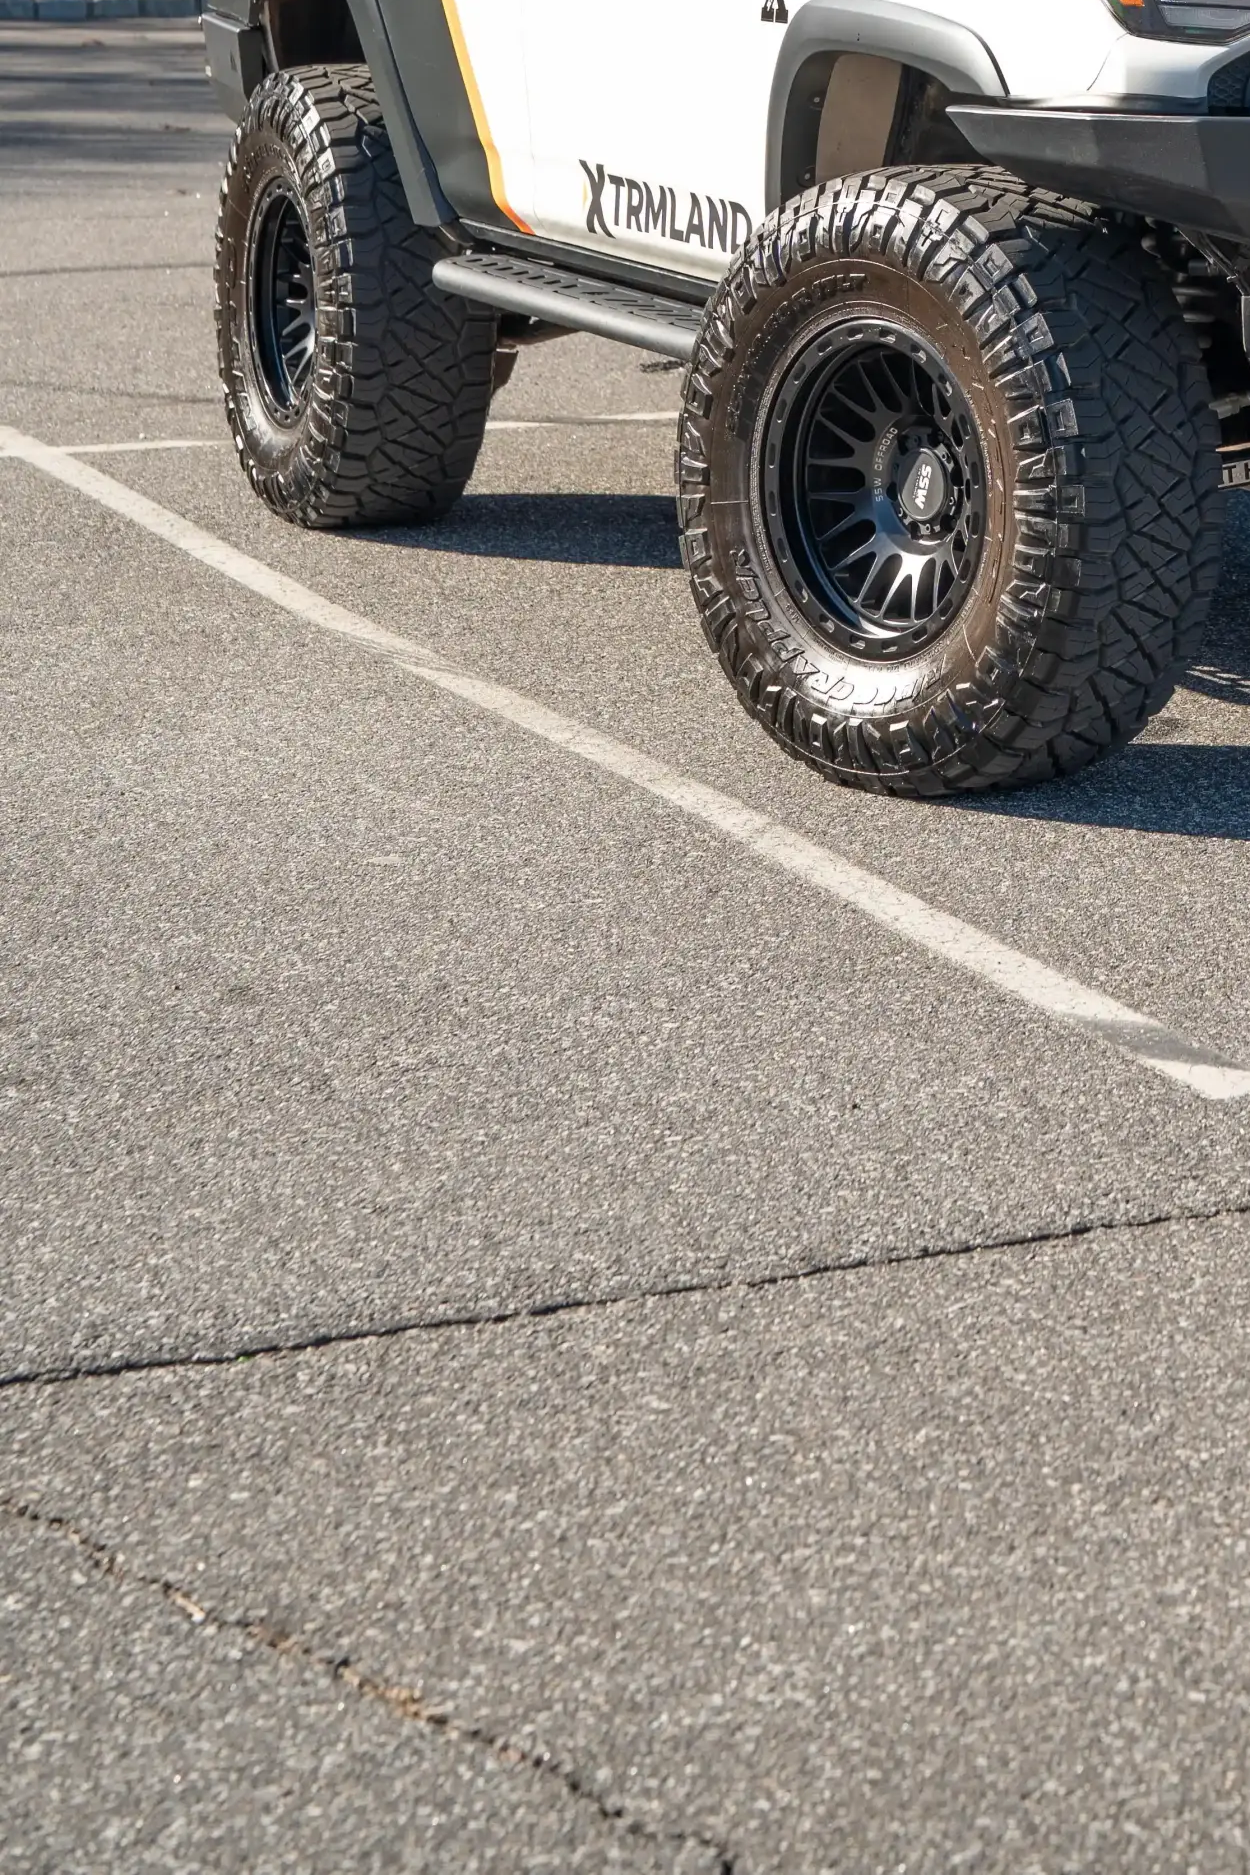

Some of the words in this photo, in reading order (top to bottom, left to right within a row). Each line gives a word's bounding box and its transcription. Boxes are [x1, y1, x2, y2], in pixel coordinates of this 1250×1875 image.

[578, 159, 753, 255] XTRMLAND
[874, 427, 899, 471] OFFROAD
[873, 477, 884, 502] SSW
[914, 463, 932, 510] SSW
